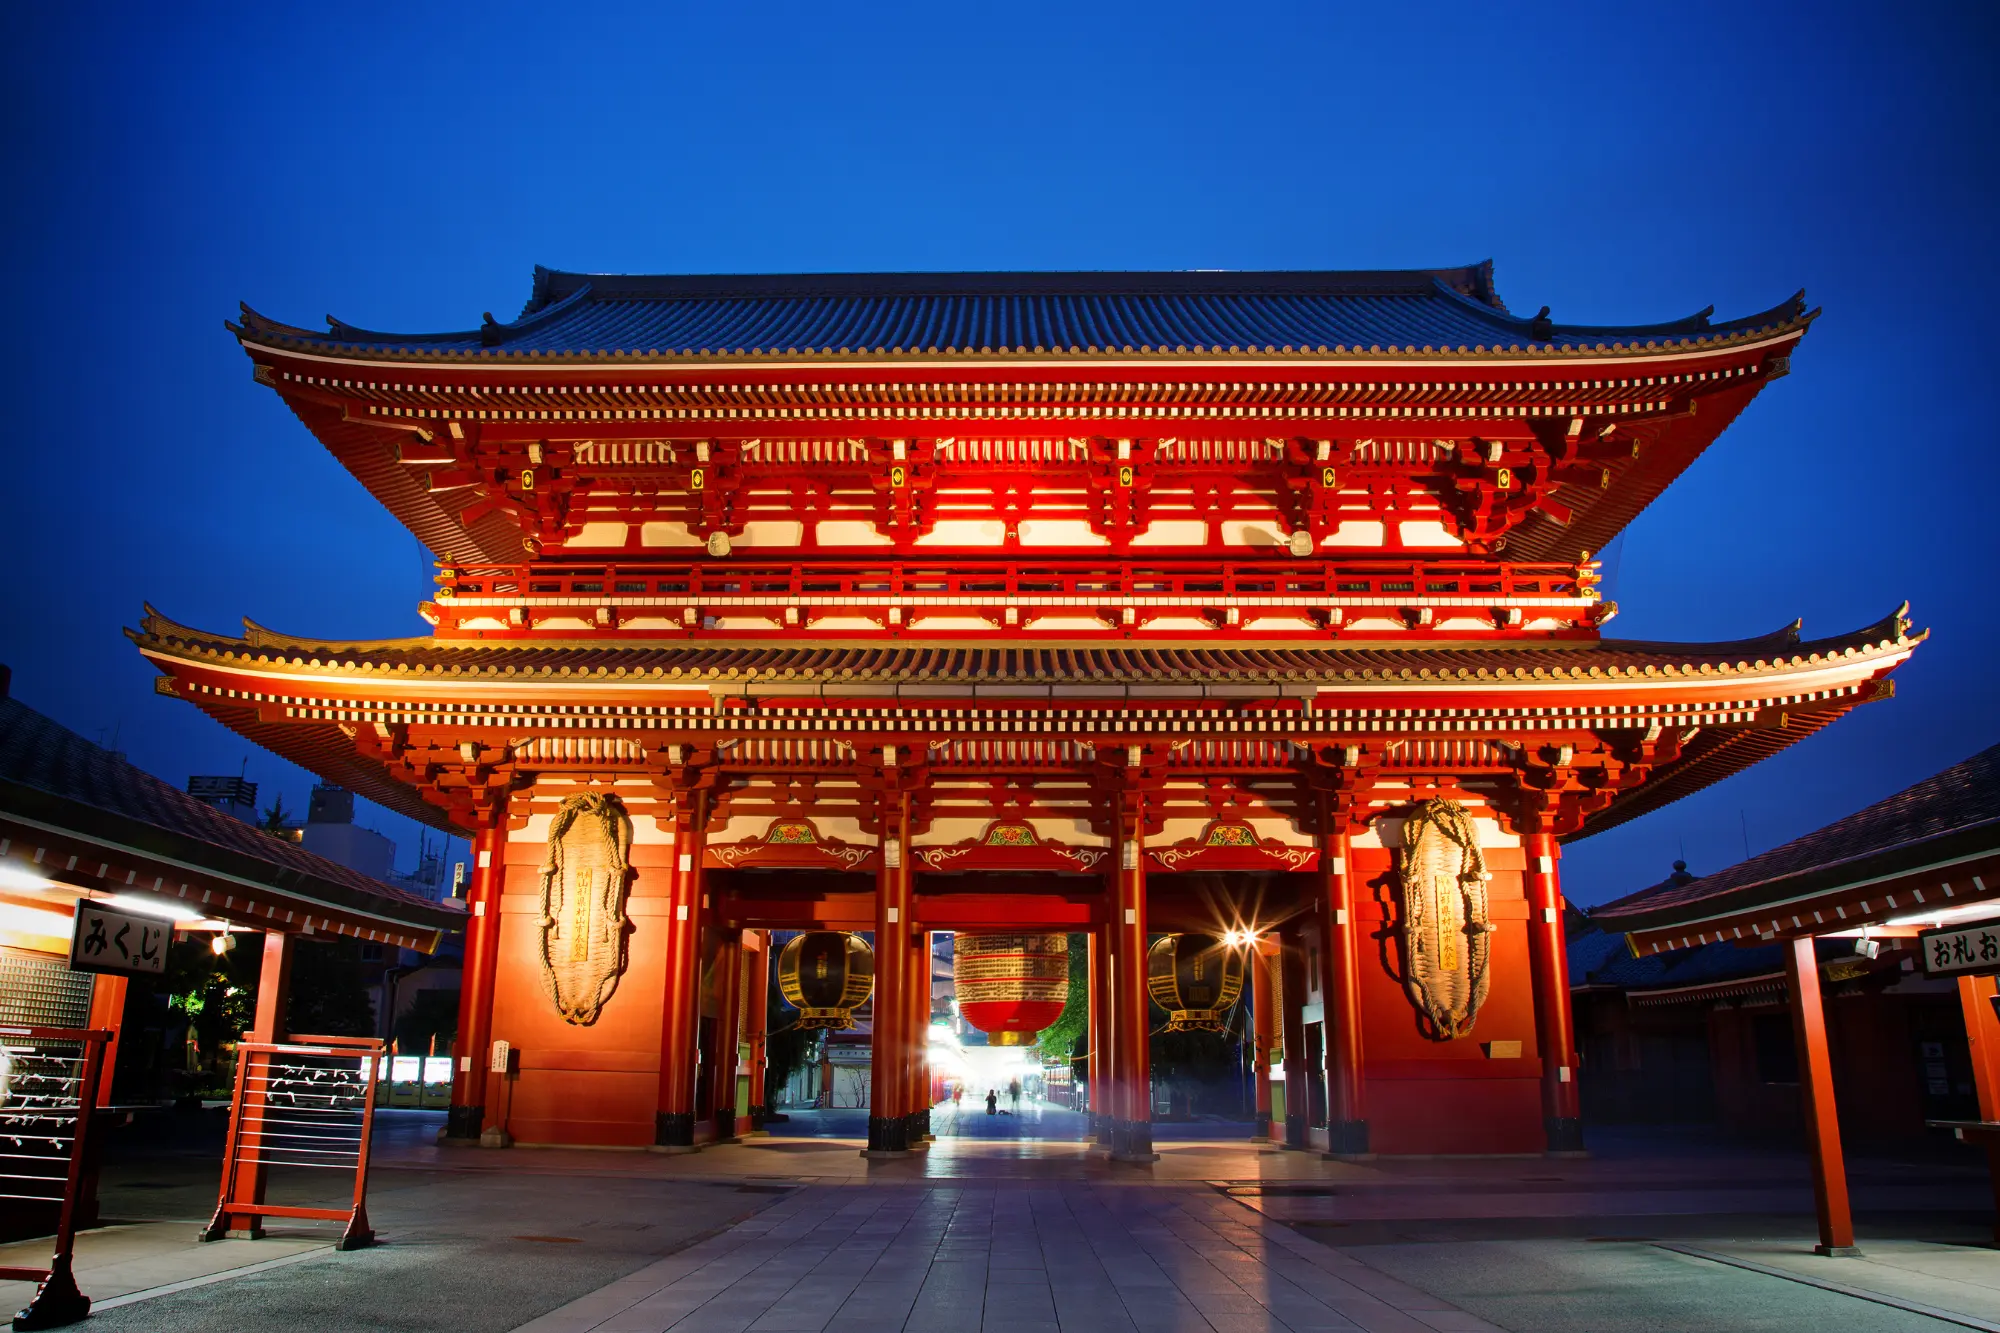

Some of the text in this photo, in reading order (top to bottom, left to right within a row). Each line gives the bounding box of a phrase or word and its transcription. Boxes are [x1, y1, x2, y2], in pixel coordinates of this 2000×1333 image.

[84, 918, 160, 961] みくじ
[1934, 931, 1998, 967] お札お
